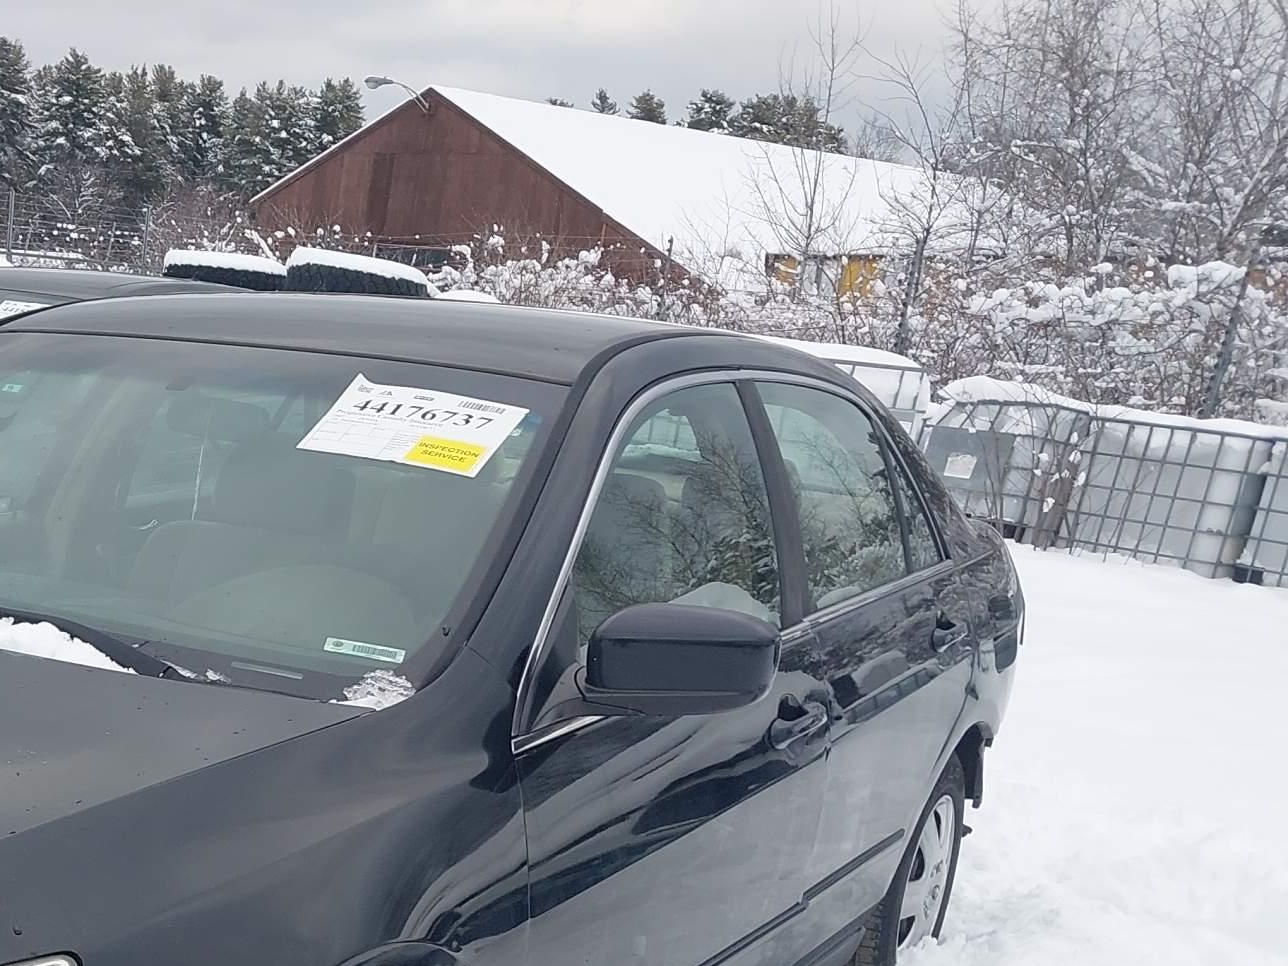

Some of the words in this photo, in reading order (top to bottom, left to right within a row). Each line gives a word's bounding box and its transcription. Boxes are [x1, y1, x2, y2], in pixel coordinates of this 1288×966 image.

[353, 399, 494, 430] 44176737
[418, 442, 480, 458] INSPECTION
[420, 449, 467, 464] SERVICE
